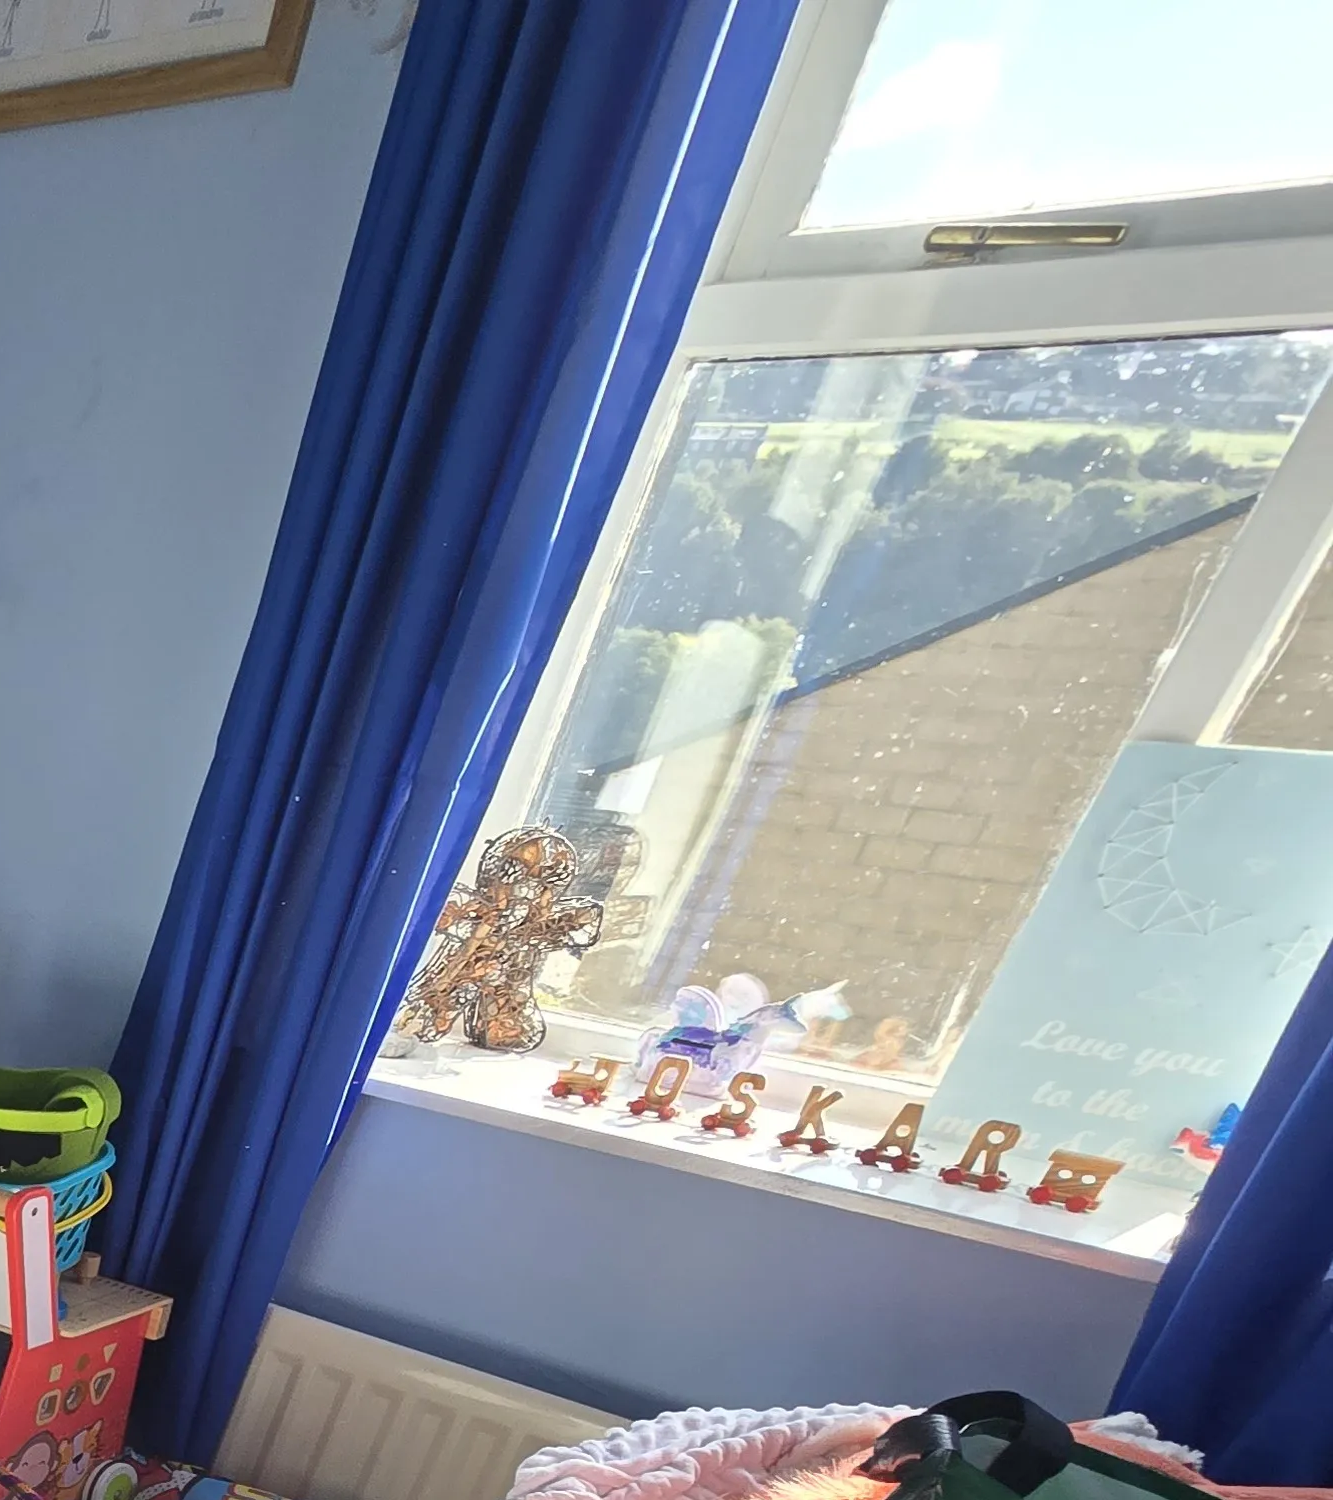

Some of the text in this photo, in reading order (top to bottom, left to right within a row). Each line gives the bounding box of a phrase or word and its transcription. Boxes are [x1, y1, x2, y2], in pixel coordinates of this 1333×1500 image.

[1020, 1019, 1227, 1077] Love you
[1032, 1079, 1150, 1121] to the
[933, 1113, 1041, 1151] mn
